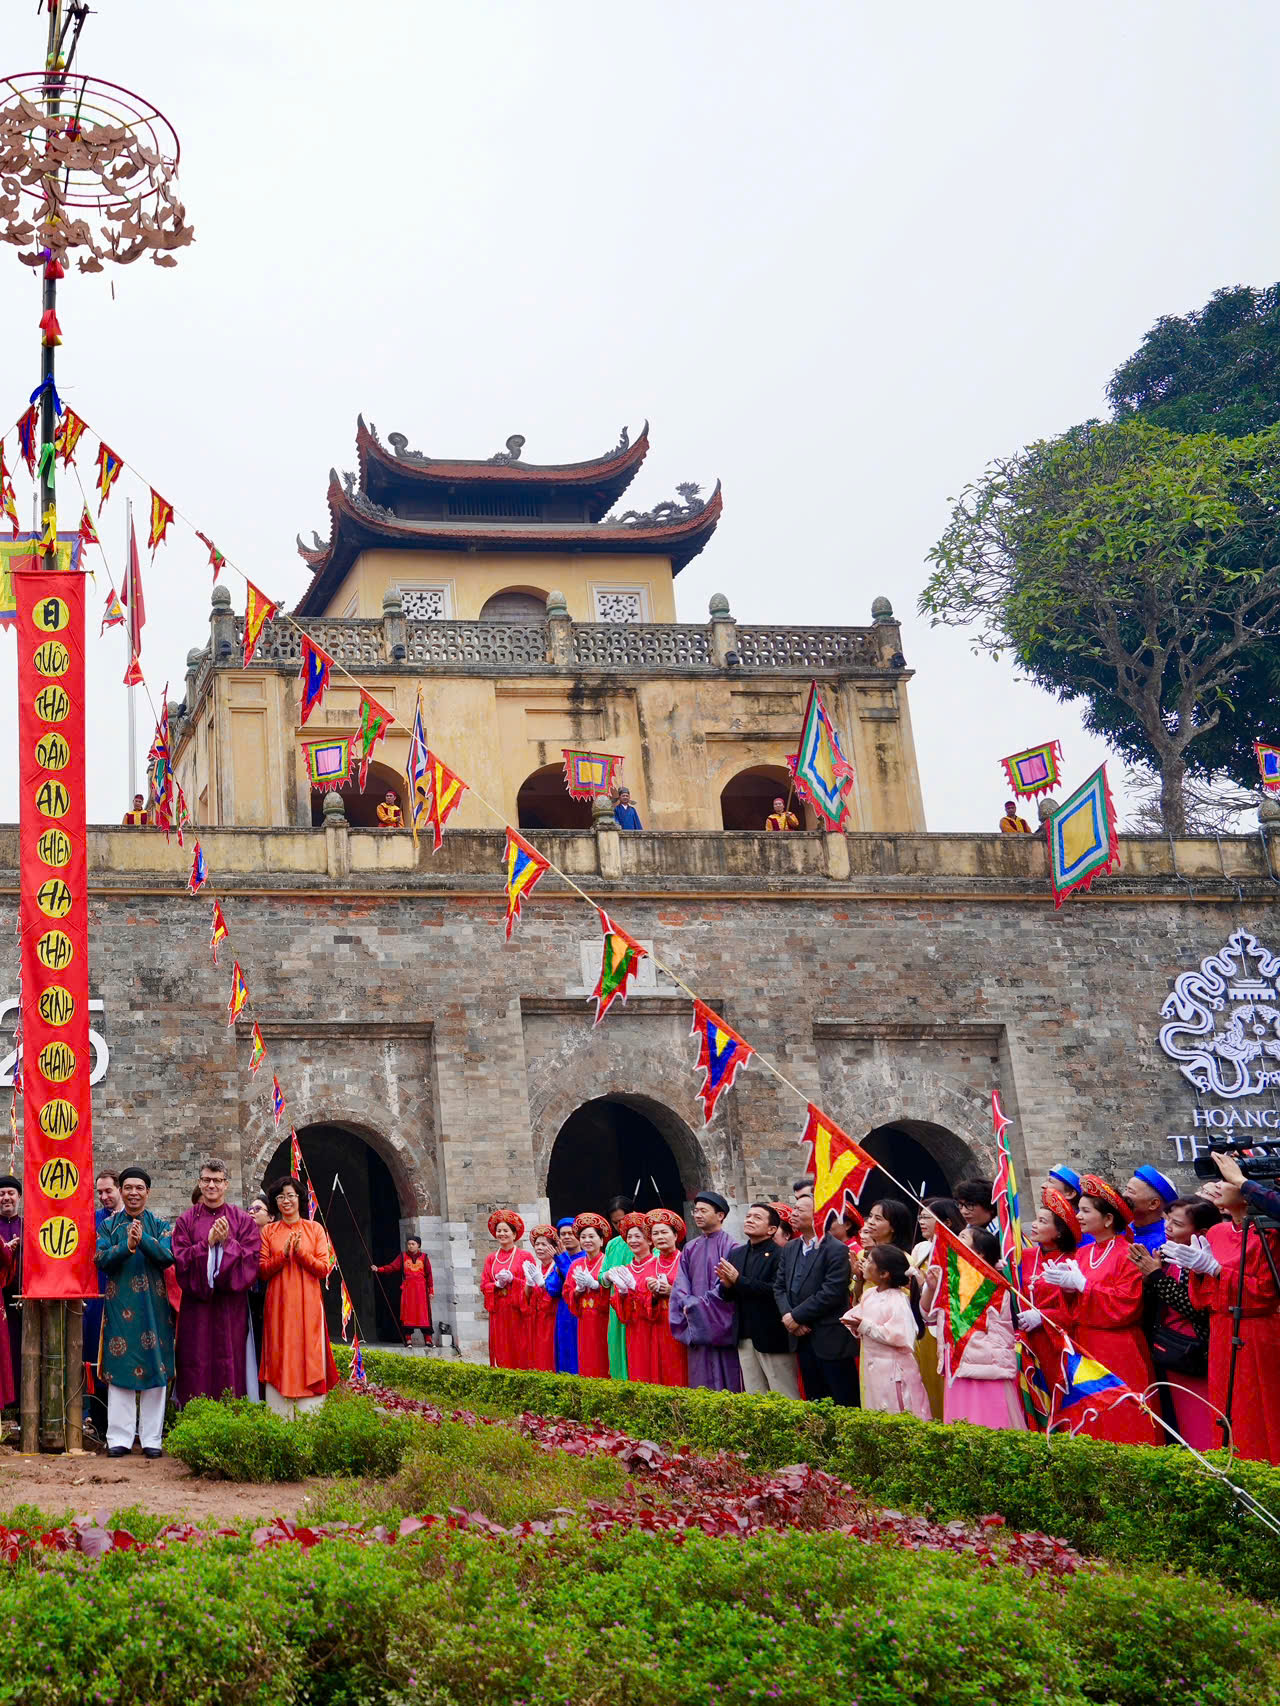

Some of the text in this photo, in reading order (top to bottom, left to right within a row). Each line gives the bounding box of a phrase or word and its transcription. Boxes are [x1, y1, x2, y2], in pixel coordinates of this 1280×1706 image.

[33, 642, 69, 675] QUỐC
[36, 688, 69, 721] THÁI
[37, 734, 68, 769] DÂN
[37, 781, 70, 817] AN
[39, 830, 71, 865] THIÊN
[38, 881, 71, 917] HẠ
[38, 933, 71, 968] THÁI
[39, 987, 74, 1023] BÌNH
[40, 1043, 76, 1080] THÁNH
[1192, 1104, 1280, 1129] HOÀNG
[40, 1159, 79, 1198] VẠN
